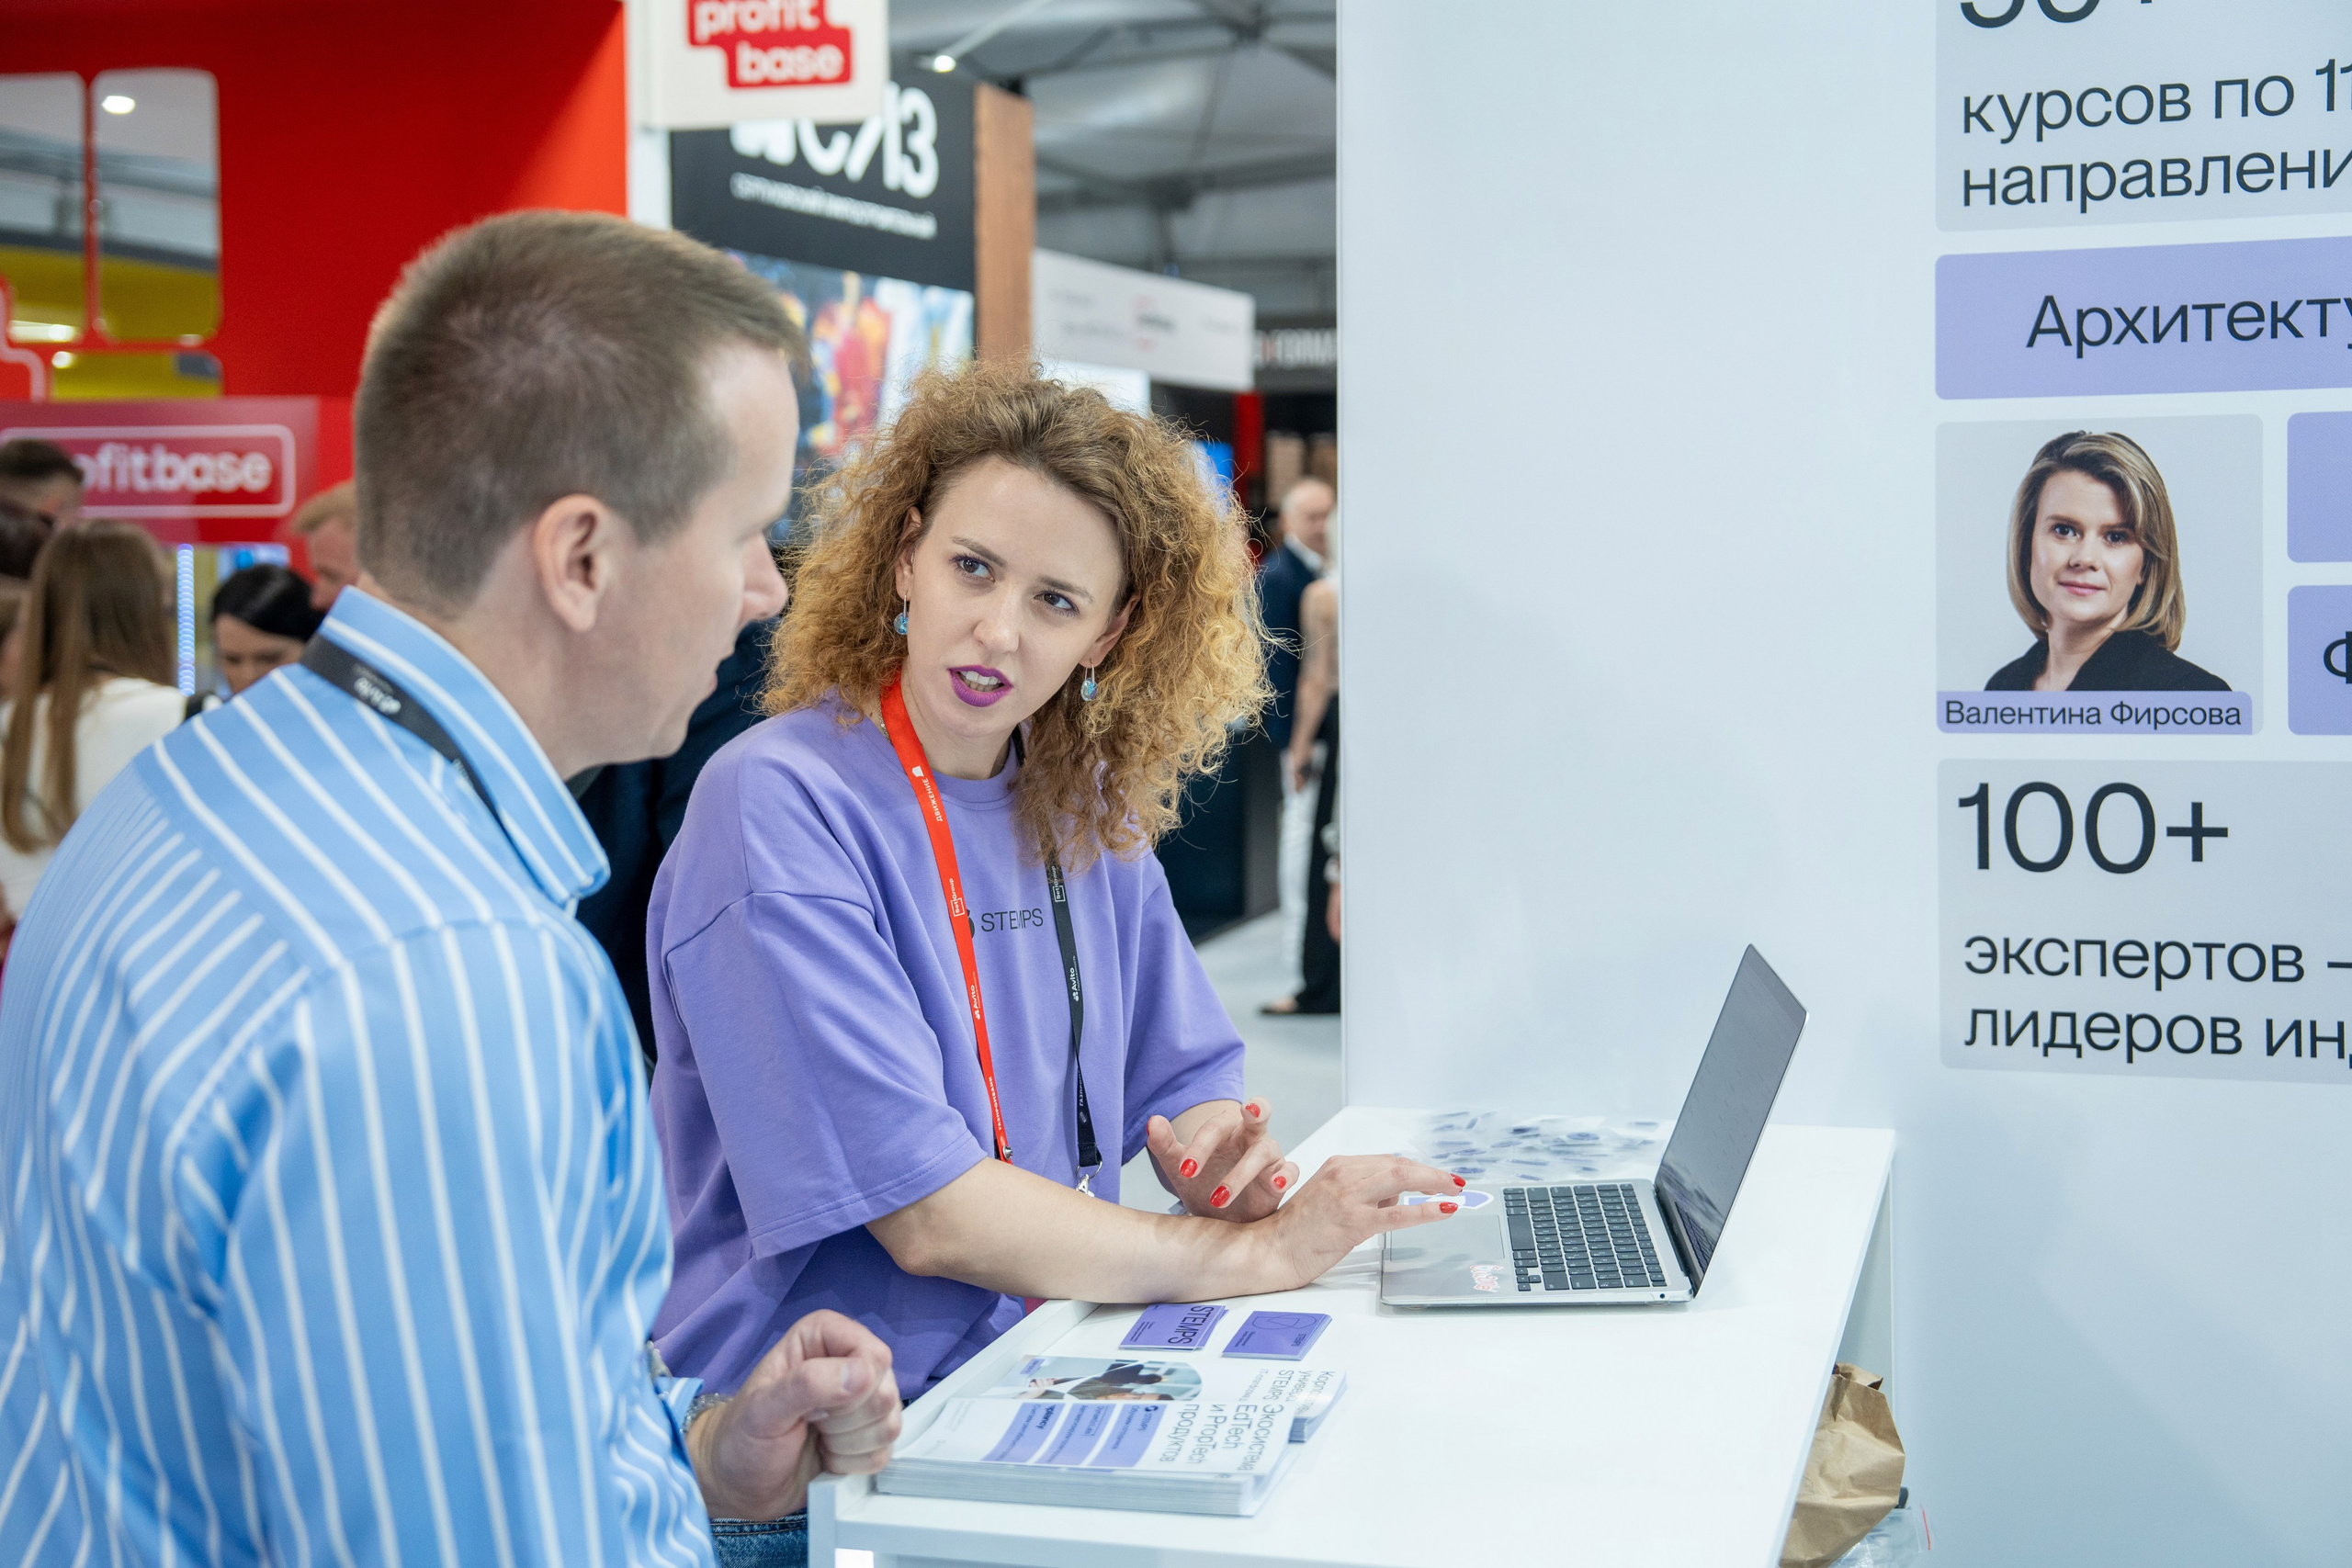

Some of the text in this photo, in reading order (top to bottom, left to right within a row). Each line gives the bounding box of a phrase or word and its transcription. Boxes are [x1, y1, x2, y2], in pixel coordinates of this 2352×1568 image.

[736, 40, 845, 84] base
[1963, 83, 2192, 144] курсов
[2214, 74, 2295, 119] по
[73, 441, 273, 492] ofitbase
[1945, 700, 2242, 731] Валентина Фирсова
[922, 778, 943, 822] ДВИЖЕНИЕ
[1958, 781, 2229, 874] 100+
[980, 908, 1044, 932] STEMPS
[1069, 967, 1078, 992] Avito
[1964, 935, 2305, 992] экспертов
[970, 985, 978, 1010] Avito
[1964, 1008, 2352, 1069] лидеров ин
[989, 1077, 1001, 1131] ГАЗПРОМБАНК
[1168, 1306, 1214, 1345] STEMPS
[1262, 1370, 1295, 1401] STEMPS
[1159, 1404, 1200, 1462] продуктов
[1185, 1404, 1227, 1464] и PropTech
[1222, 1404, 1258, 1449] EdTech
[1238, 1404, 1284, 1471] Экосистема
